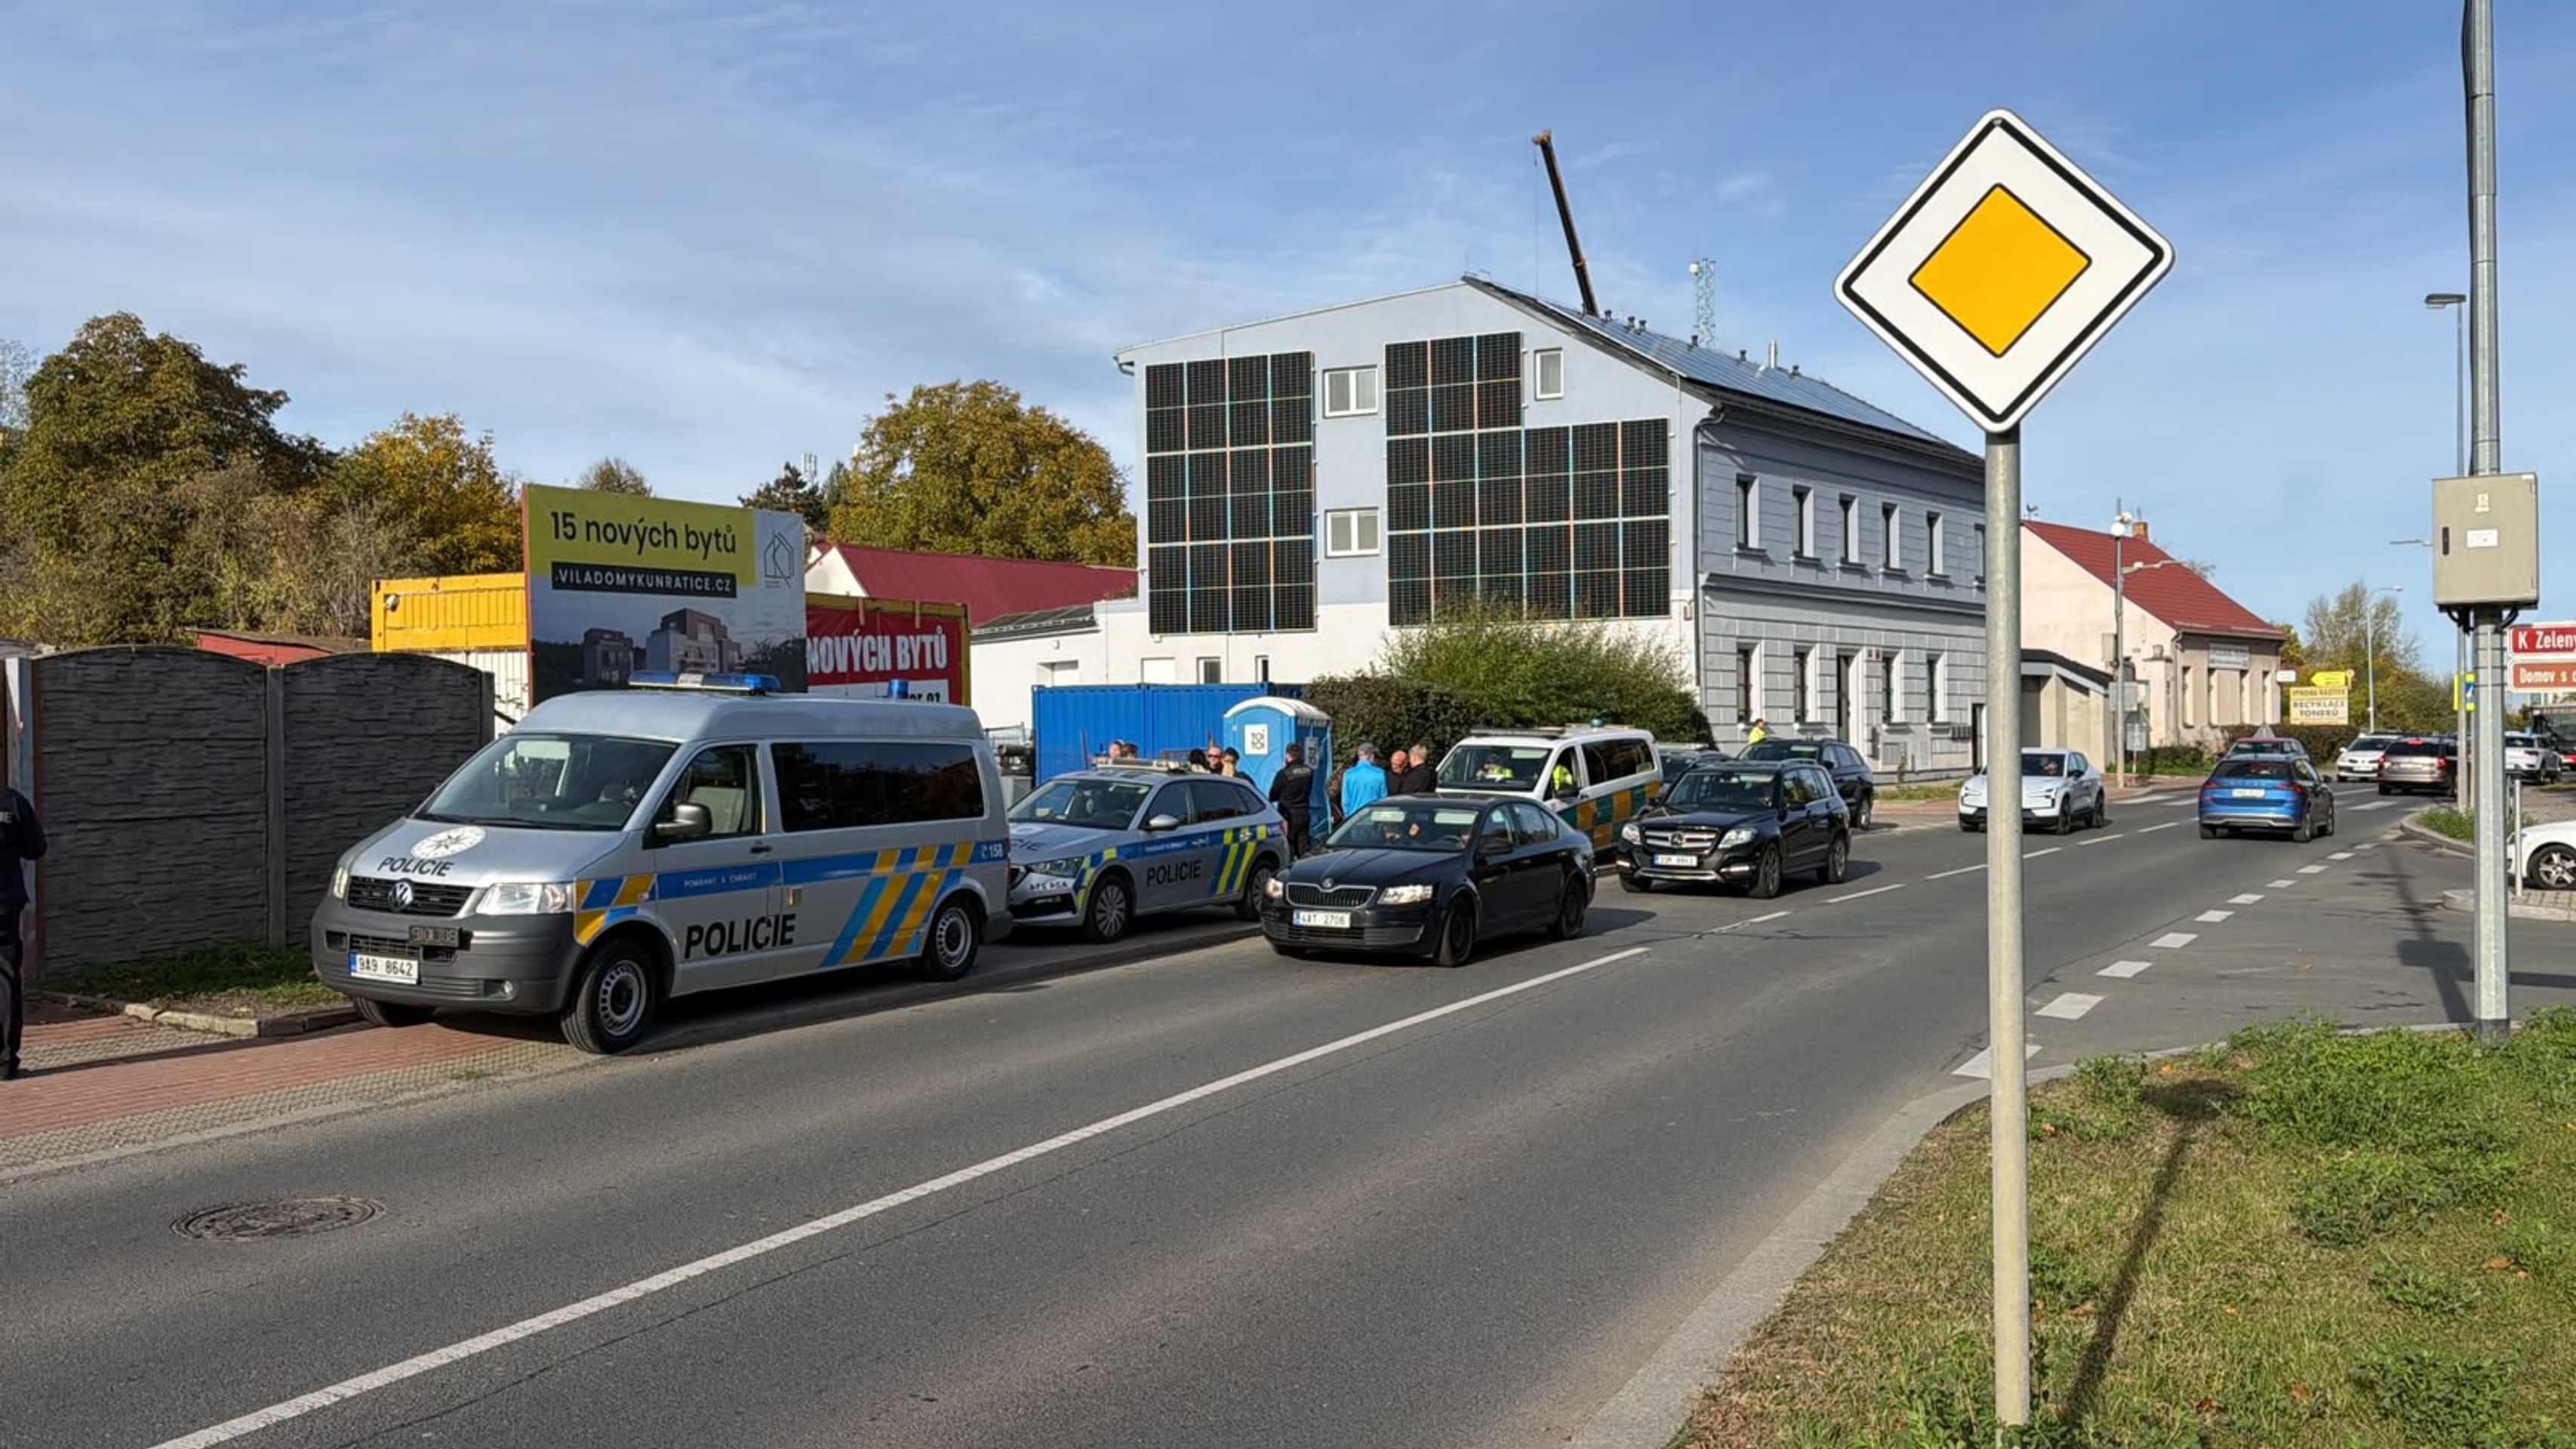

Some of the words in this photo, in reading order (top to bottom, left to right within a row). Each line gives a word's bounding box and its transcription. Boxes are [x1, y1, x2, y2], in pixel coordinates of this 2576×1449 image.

[551, 512, 577, 540] 15
[585, 518, 678, 556] nových
[685, 524, 736, 561] bytů
[557, 568, 731, 592] VILADOMYKUNRATICE.CZ
[807, 628, 892, 674] NOVÝCH
[897, 625, 947, 670] BYTŮ
[2518, 630, 2528, 649] K
[2519, 668, 2555, 683] Domov
[2560, 670, 2568, 682] s
[989, 843, 1003, 859] 158
[377, 857, 454, 877] POLICIE
[1146, 860, 1202, 887] POLICIE
[684, 913, 796, 959] POLICIE
[358, 955, 378, 974] 9A9
[384, 960, 414, 977] 8642
